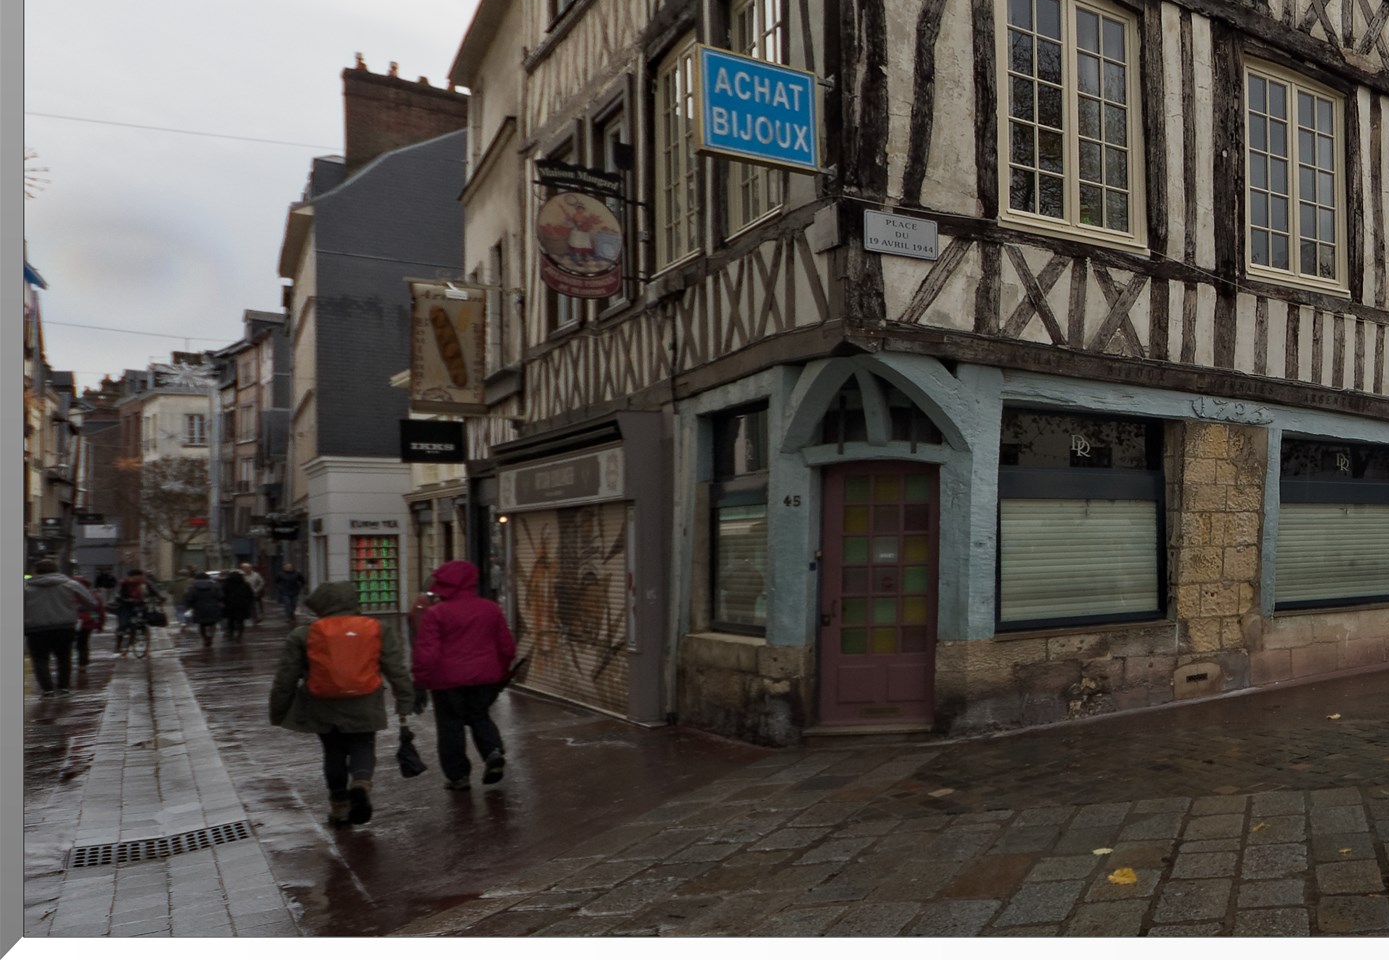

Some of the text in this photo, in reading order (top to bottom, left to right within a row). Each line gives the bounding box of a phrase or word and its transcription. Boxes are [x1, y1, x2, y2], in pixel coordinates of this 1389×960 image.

[714, 67, 803, 112] ACHAT
[712, 106, 809, 153] BIJOUX
[885, 219, 918, 231] PLACE
[895, 231, 909, 240] DU
[869, 237, 934, 253] 19 AVRIL 1944
[409, 442, 456, 451] IKKS
[783, 495, 801, 507] 45
